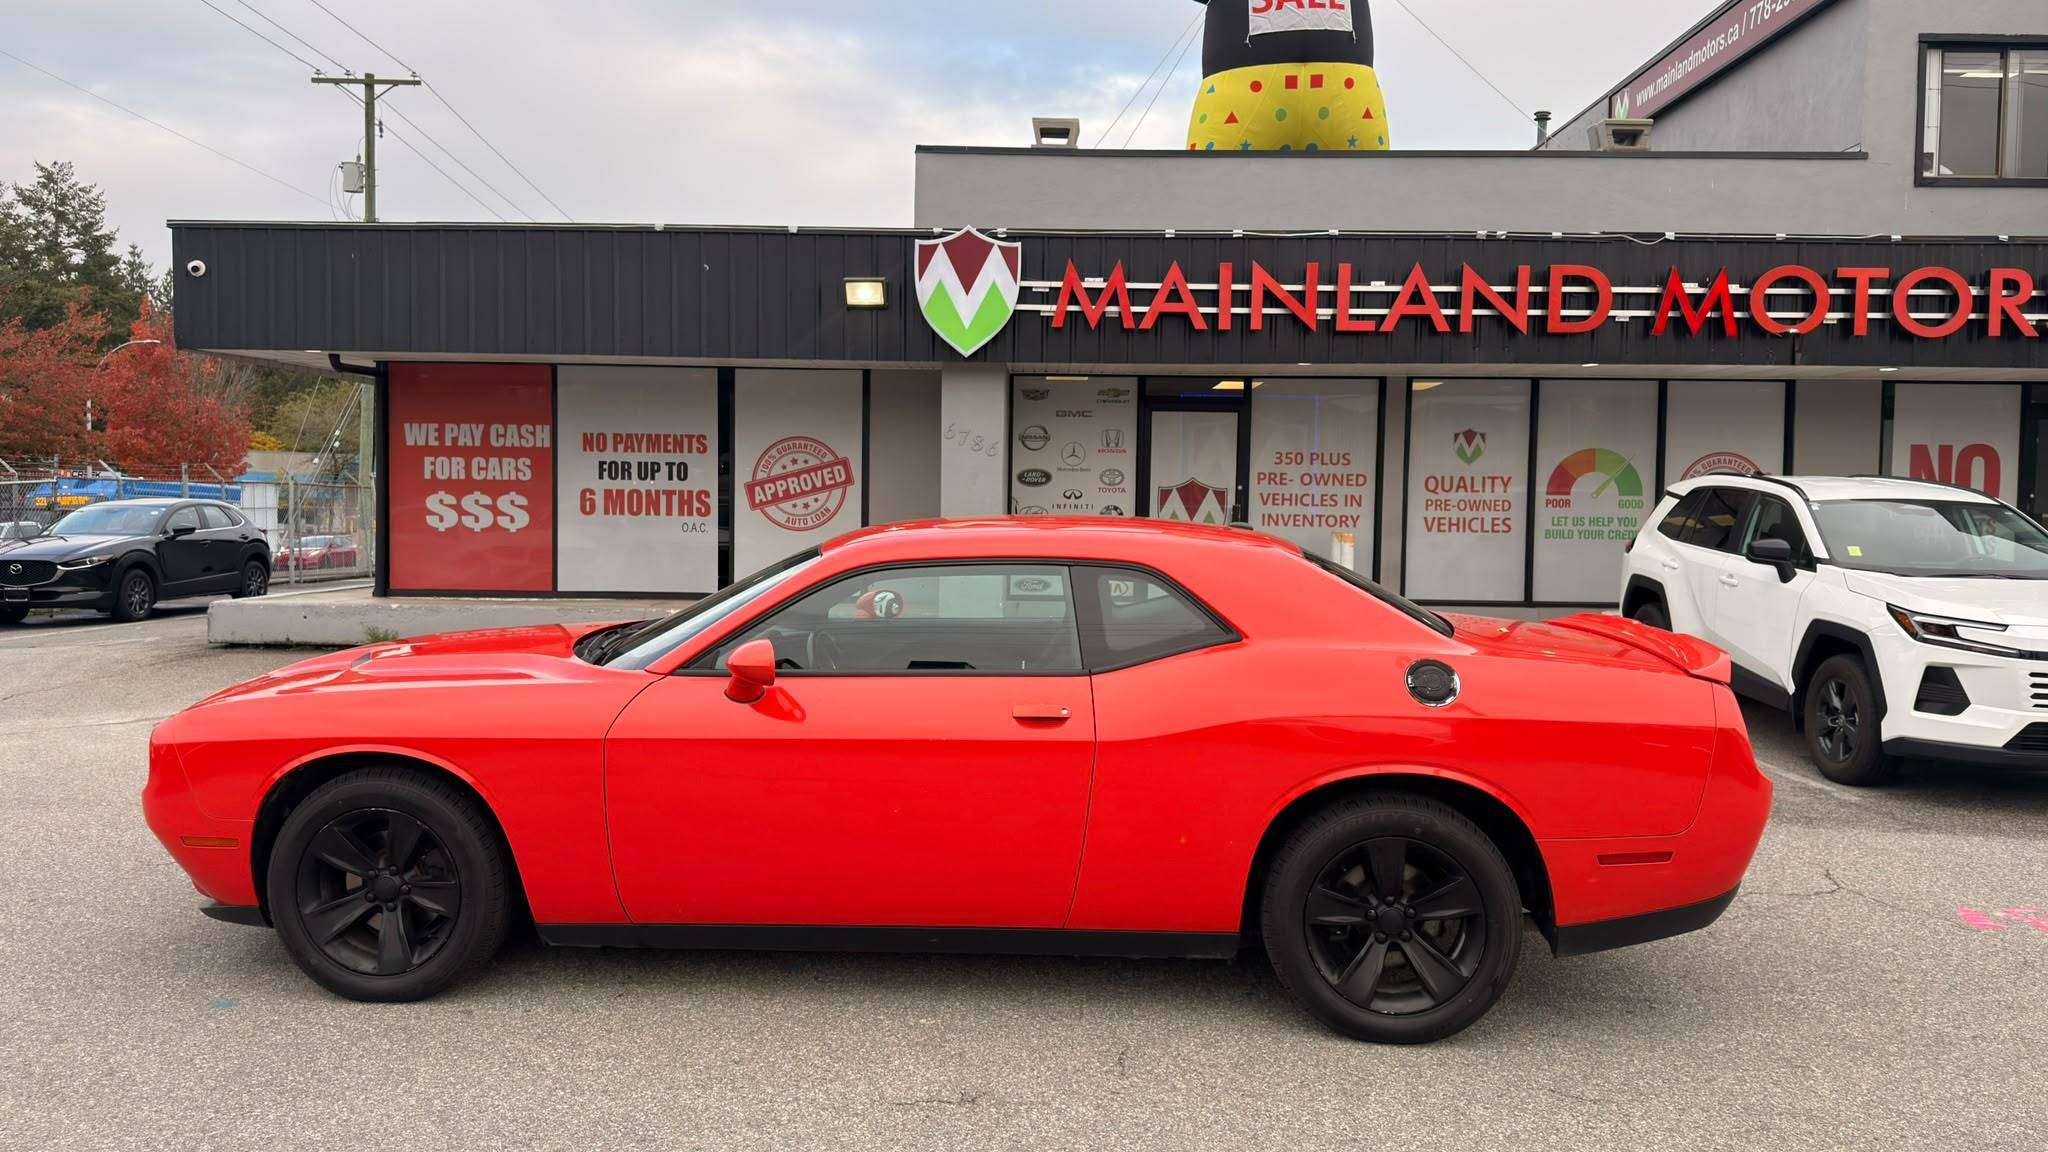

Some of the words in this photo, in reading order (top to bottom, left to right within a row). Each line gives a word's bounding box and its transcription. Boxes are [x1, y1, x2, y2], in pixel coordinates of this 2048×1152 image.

[1635, 23, 1739, 108] www.mainlandmotors.ca
[1750, 0, 1790, 30] 778-2
[1051, 258, 1614, 335] MAINLAND
[1056, 410, 1094, 418] GMC
[404, 423, 439, 447] WE
[445, 423, 485, 447] PAY
[489, 424, 550, 448] CASH
[582, 432, 608, 453] NO
[612, 433, 708, 455] PAYMENTS
[777, 441, 828, 460] GUARANTEED
[1274, 451, 1304, 466] 350
[1309, 452, 1351, 466] PLUS
[423, 456, 466, 480] FOR
[471, 456, 532, 481] CARS
[598, 460, 632, 481] FOR
[637, 461, 661, 481] UP
[665, 461, 689, 482] TO
[1701, 457, 1752, 475] GUARANTEED
[754, 465, 847, 504] APPROVED
[1257, 472, 1294, 486] PRE-
[1300, 472, 1367, 487] OWNED
[1424, 475, 1512, 494] QUALITY
[580, 488, 596, 516] 6
[603, 488, 712, 518] MONTHS
[1260, 493, 1339, 507] VEHICLES
[1344, 494, 1363, 507] IN
[1425, 499, 1512, 512] PRE-OWNED
[1545, 499, 1571, 509] POOR
[1618, 500, 1644, 510] GOOD
[425, 491, 530, 533] $$$
[784, 516, 808, 526] AUTO
[811, 506, 832, 524] LOAN
[1262, 513, 1361, 528] INVENTORY
[682, 522, 709, 533] O.A.C.
[1424, 516, 1512, 534] VEHICLES
[1552, 516, 1570, 527] LET
[1572, 516, 1586, 527] US
[1589, 516, 1614, 528] HELP
[1617, 517, 1638, 528] YOU
[1544, 529, 1575, 540] BUILD
[1577, 529, 1604, 540] YOUR
